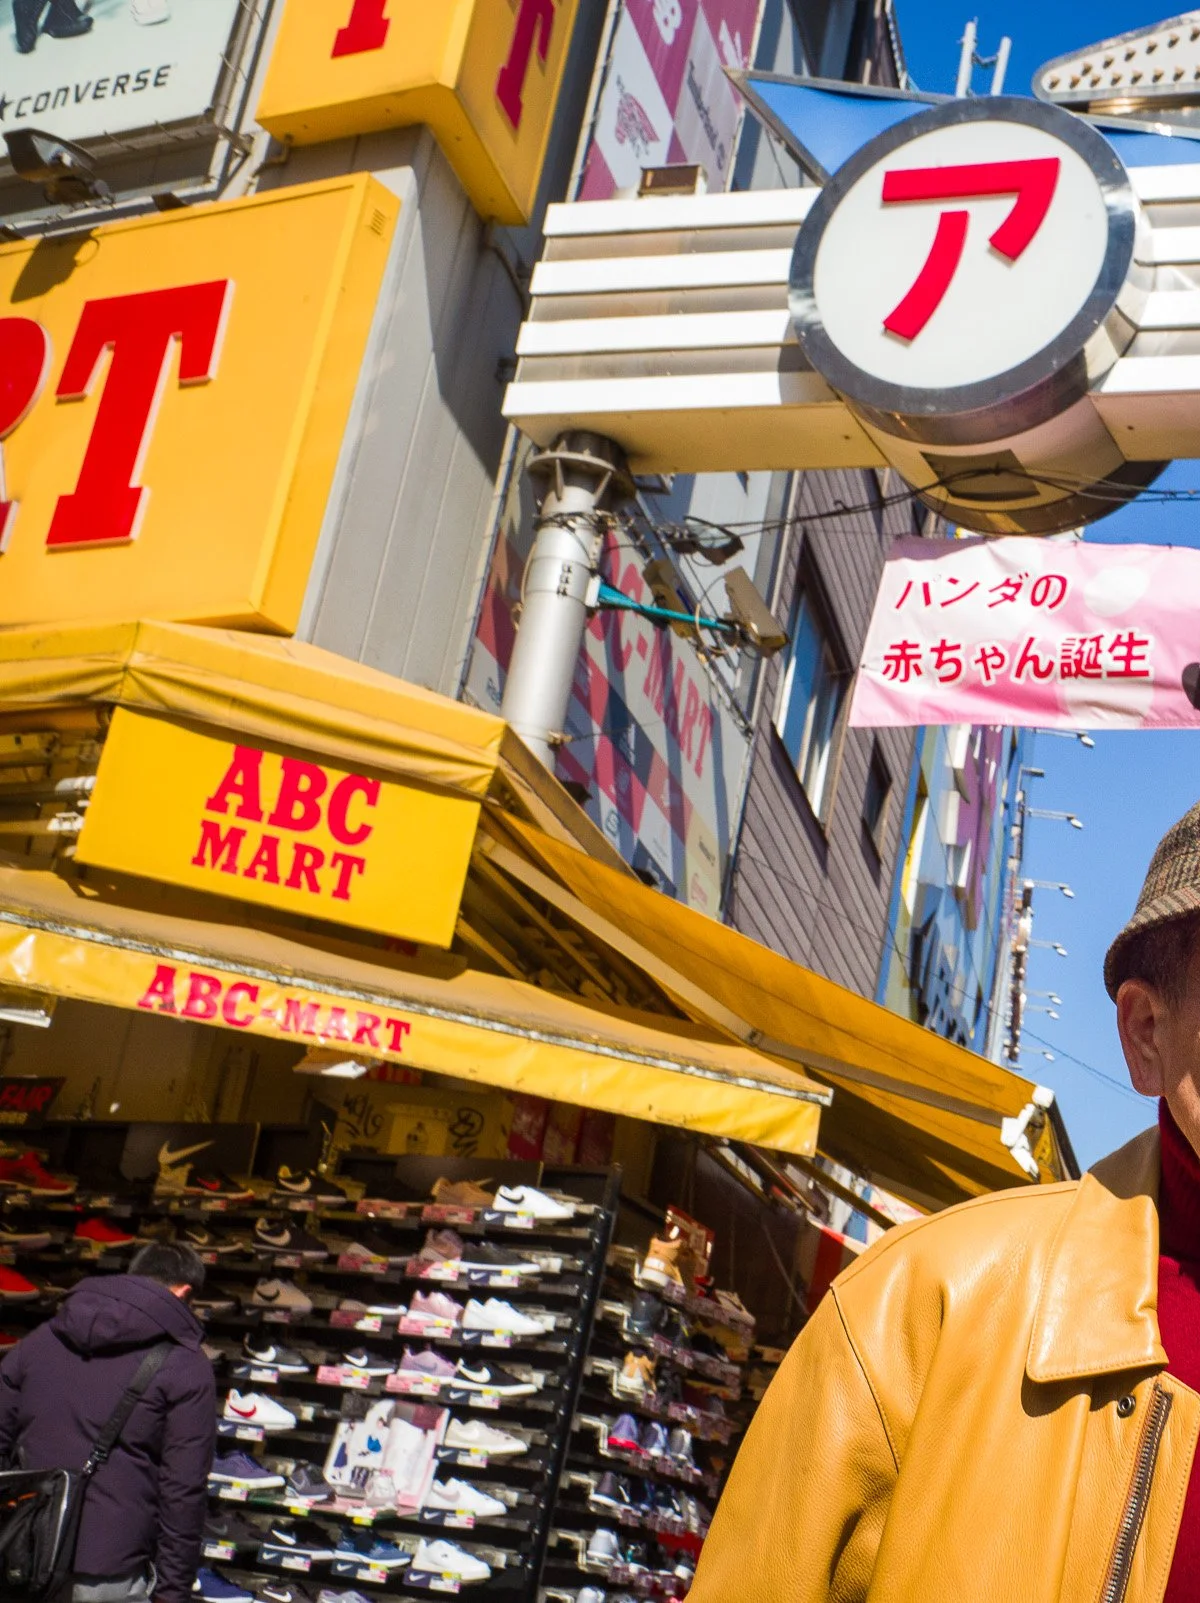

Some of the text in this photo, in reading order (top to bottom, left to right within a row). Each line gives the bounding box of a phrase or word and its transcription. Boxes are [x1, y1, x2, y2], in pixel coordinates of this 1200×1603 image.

[15, 65, 171, 118] CONVERSE
[882, 631, 1150, 684] 赤ちゃん誕生
[205, 743, 382, 847] ABC
[190, 819, 366, 902] MART
[136, 963, 412, 1054] ABC-MART
